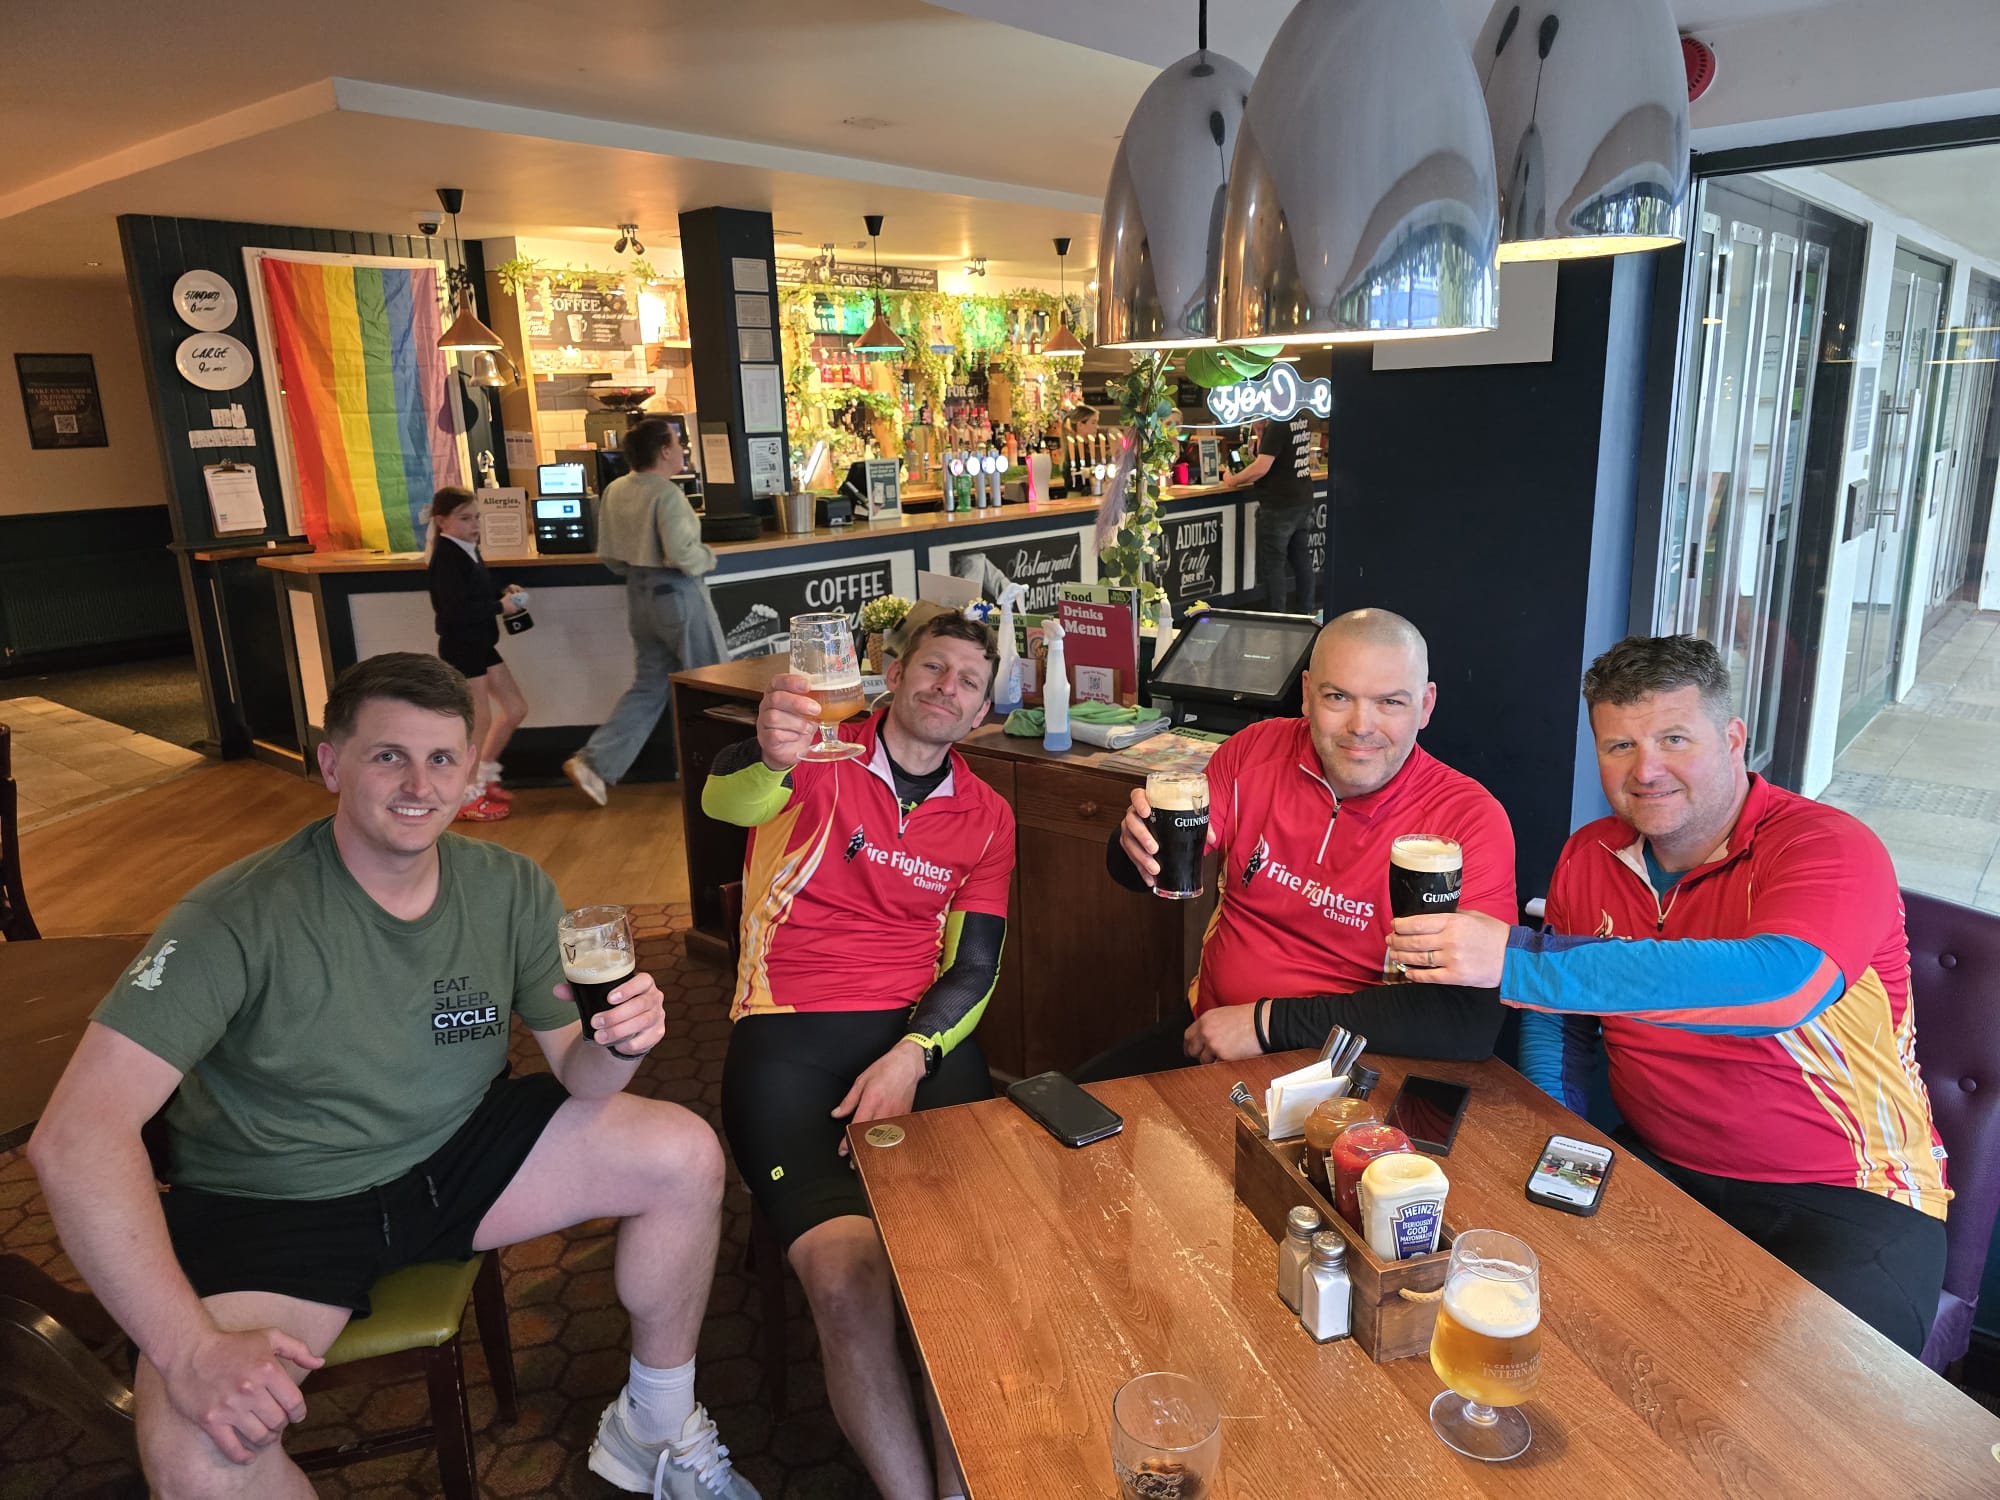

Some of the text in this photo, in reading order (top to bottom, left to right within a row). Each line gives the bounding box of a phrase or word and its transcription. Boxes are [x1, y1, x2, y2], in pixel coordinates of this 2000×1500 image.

[840, 273, 870, 286] GINS
[184, 290, 220, 302] STANDARD
[192, 347, 229, 358] LARGE
[1175, 520, 1218, 551] ADULTS
[1012, 544, 1078, 579] Restaurant
[1037, 572, 1053, 584] and
[805, 570, 885, 608] COFFEE
[1065, 592, 1092, 602] Food
[1063, 605, 1104, 621] Drinks
[1064, 619, 1107, 637] Menu
[890, 850, 953, 881] Fighters
[913, 877, 947, 895] Charity
[1267, 861, 1375, 918] Fire Fighters
[1323, 908, 1369, 932] Charity
[434, 992, 493, 1011] SLEEP.
[434, 1007, 497, 1028] CYCLE
[434, 1022, 506, 1046] REPEAT.
[1404, 1204, 1433, 1218] HEINZ
[1407, 1226, 1428, 1236] GOOD
